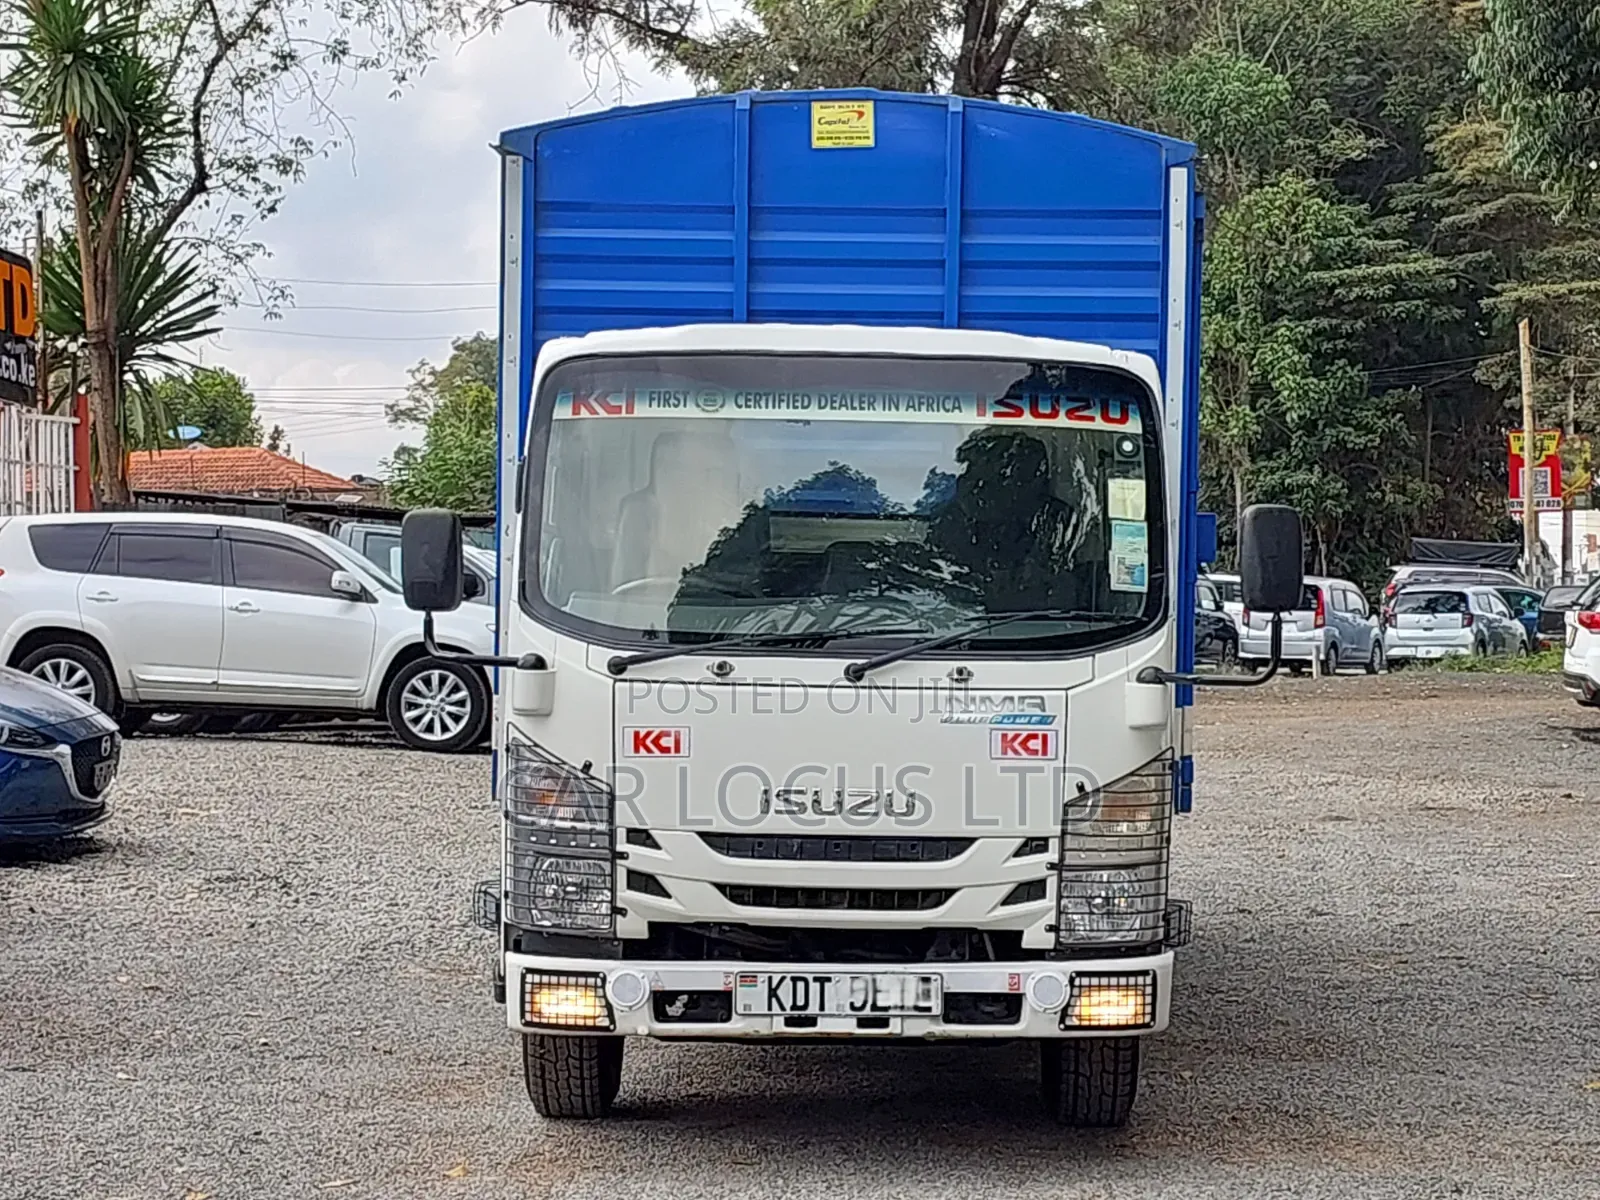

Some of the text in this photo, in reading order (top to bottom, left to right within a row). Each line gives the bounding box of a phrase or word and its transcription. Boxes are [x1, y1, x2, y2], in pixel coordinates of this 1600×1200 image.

[818, 116, 850, 126] Capital
[571, 391, 636, 416] KCI
[648, 390, 690, 409] FIRST
[734, 391, 812, 411] CERTIFIED
[817, 393, 877, 412] DEALER
[882, 393, 900, 412] IN
[905, 394, 963, 414] AFRICA
[976, 391, 1130, 425] ISUZU
[633, 730, 681, 754] KCI
[1000, 733, 1048, 756] KCI
[759, 786, 916, 817] ISUZU
[766, 975, 832, 1012] KDT
